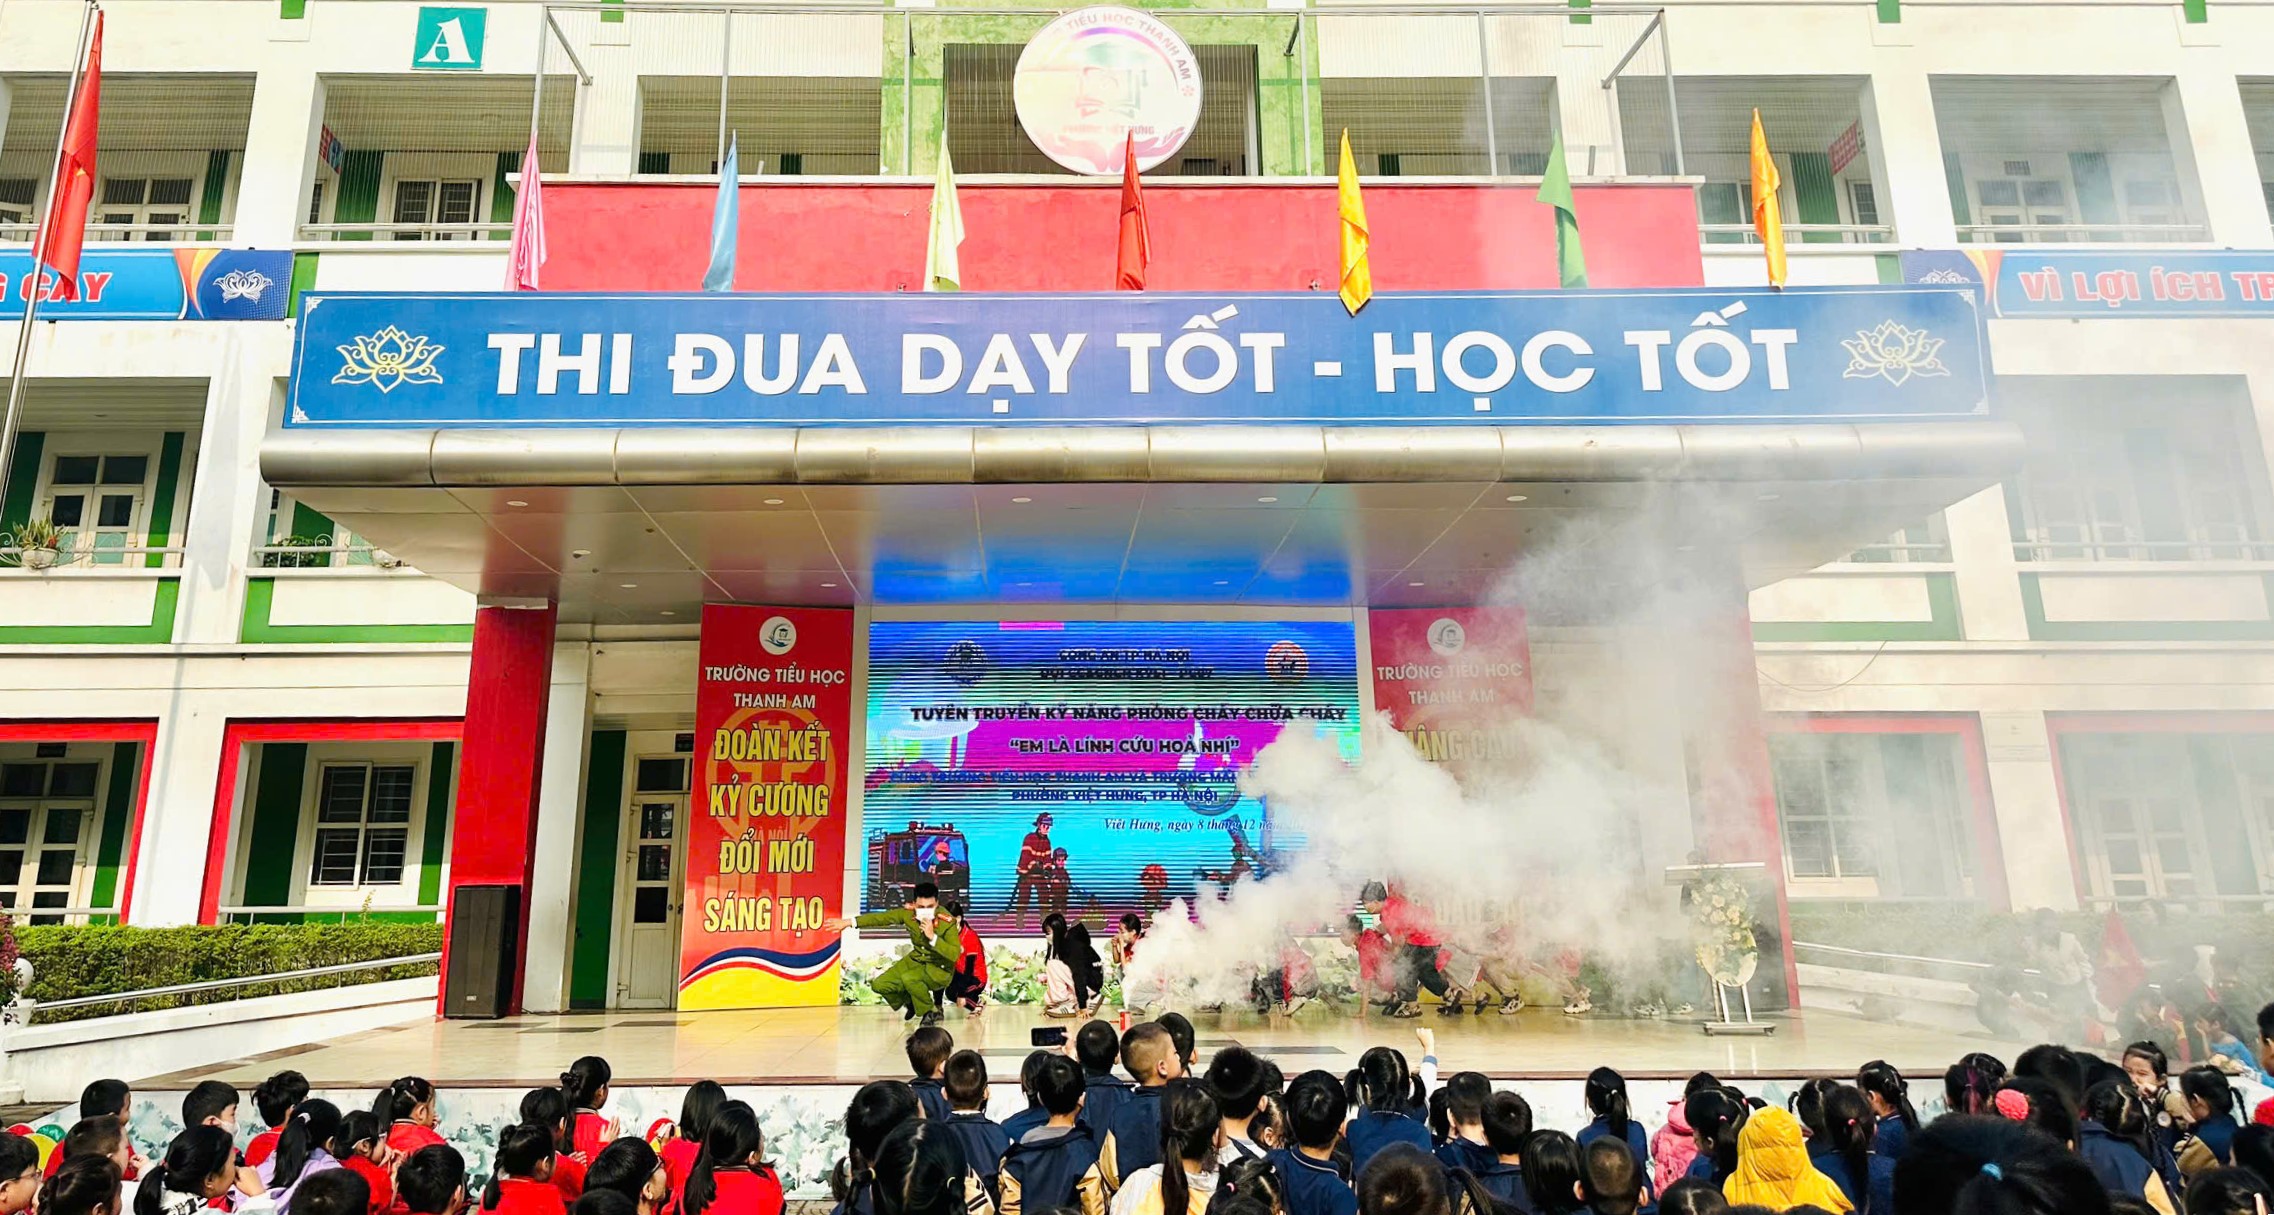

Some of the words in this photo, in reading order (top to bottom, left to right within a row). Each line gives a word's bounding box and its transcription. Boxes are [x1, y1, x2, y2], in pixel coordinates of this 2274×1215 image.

[418, 16, 475, 63] A
[1174, 57, 1192, 81] AM
[2018, 266, 2064, 301] VÌ
[2071, 269, 2142, 308] LỢI
[2150, 266, 2225, 301] ÍCH
[487, 332, 633, 395] THI
[667, 332, 867, 396] ĐUA
[901, 332, 1088, 414] DẠY
[1116, 303, 1285, 394] TỐT
[1313, 361, 1342, 376] -
[1372, 330, 1597, 412] HỌC
[1623, 299, 1799, 391] TỐT
[704, 663, 771, 683] TRƯỜNG
[774, 661, 806, 684] TIỂU
[809, 669, 846, 687] HỌC
[1377, 662, 1444, 681] TRƯỜNG
[1485, 662, 1523, 681] HỌC
[733, 692, 787, 709] THANH
[791, 694, 817, 709] AM
[1408, 690, 1463, 705] THANH
[1469, 689, 1495, 704] AM
[910, 704, 968, 721] TUYÊN
[973, 702, 1041, 720] TRUYỀN
[1045, 702, 1069, 720] KỸ
[1245, 703, 1294, 720] CHỮA
[714, 722, 781, 761] ĐOÀN
[787, 720, 831, 761] KẾT
[1048, 736, 1069, 753] LÀ
[1075, 736, 1115, 753] LÍNH
[1118, 735, 1154, 753] CỨU
[709, 773, 742, 817] KỶ
[748, 781, 830, 817] CƯƠNG
[1152, 790, 1168, 801] TP
[1172, 786, 1190, 801] HÀ
[1195, 787, 1218, 805] NỘI
[1104, 818, 1126, 832] Việt
[1167, 818, 1194, 832] ngày
[1198, 819, 1204, 830] 8
[1206, 818, 1240, 832] tháng
[1243, 818, 1256, 830] 12
[719, 827, 761, 874] ĐỔI
[767, 832, 816, 874] MỚI
[703, 890, 773, 933] SÁNG
[779, 895, 825, 938] TẠO
